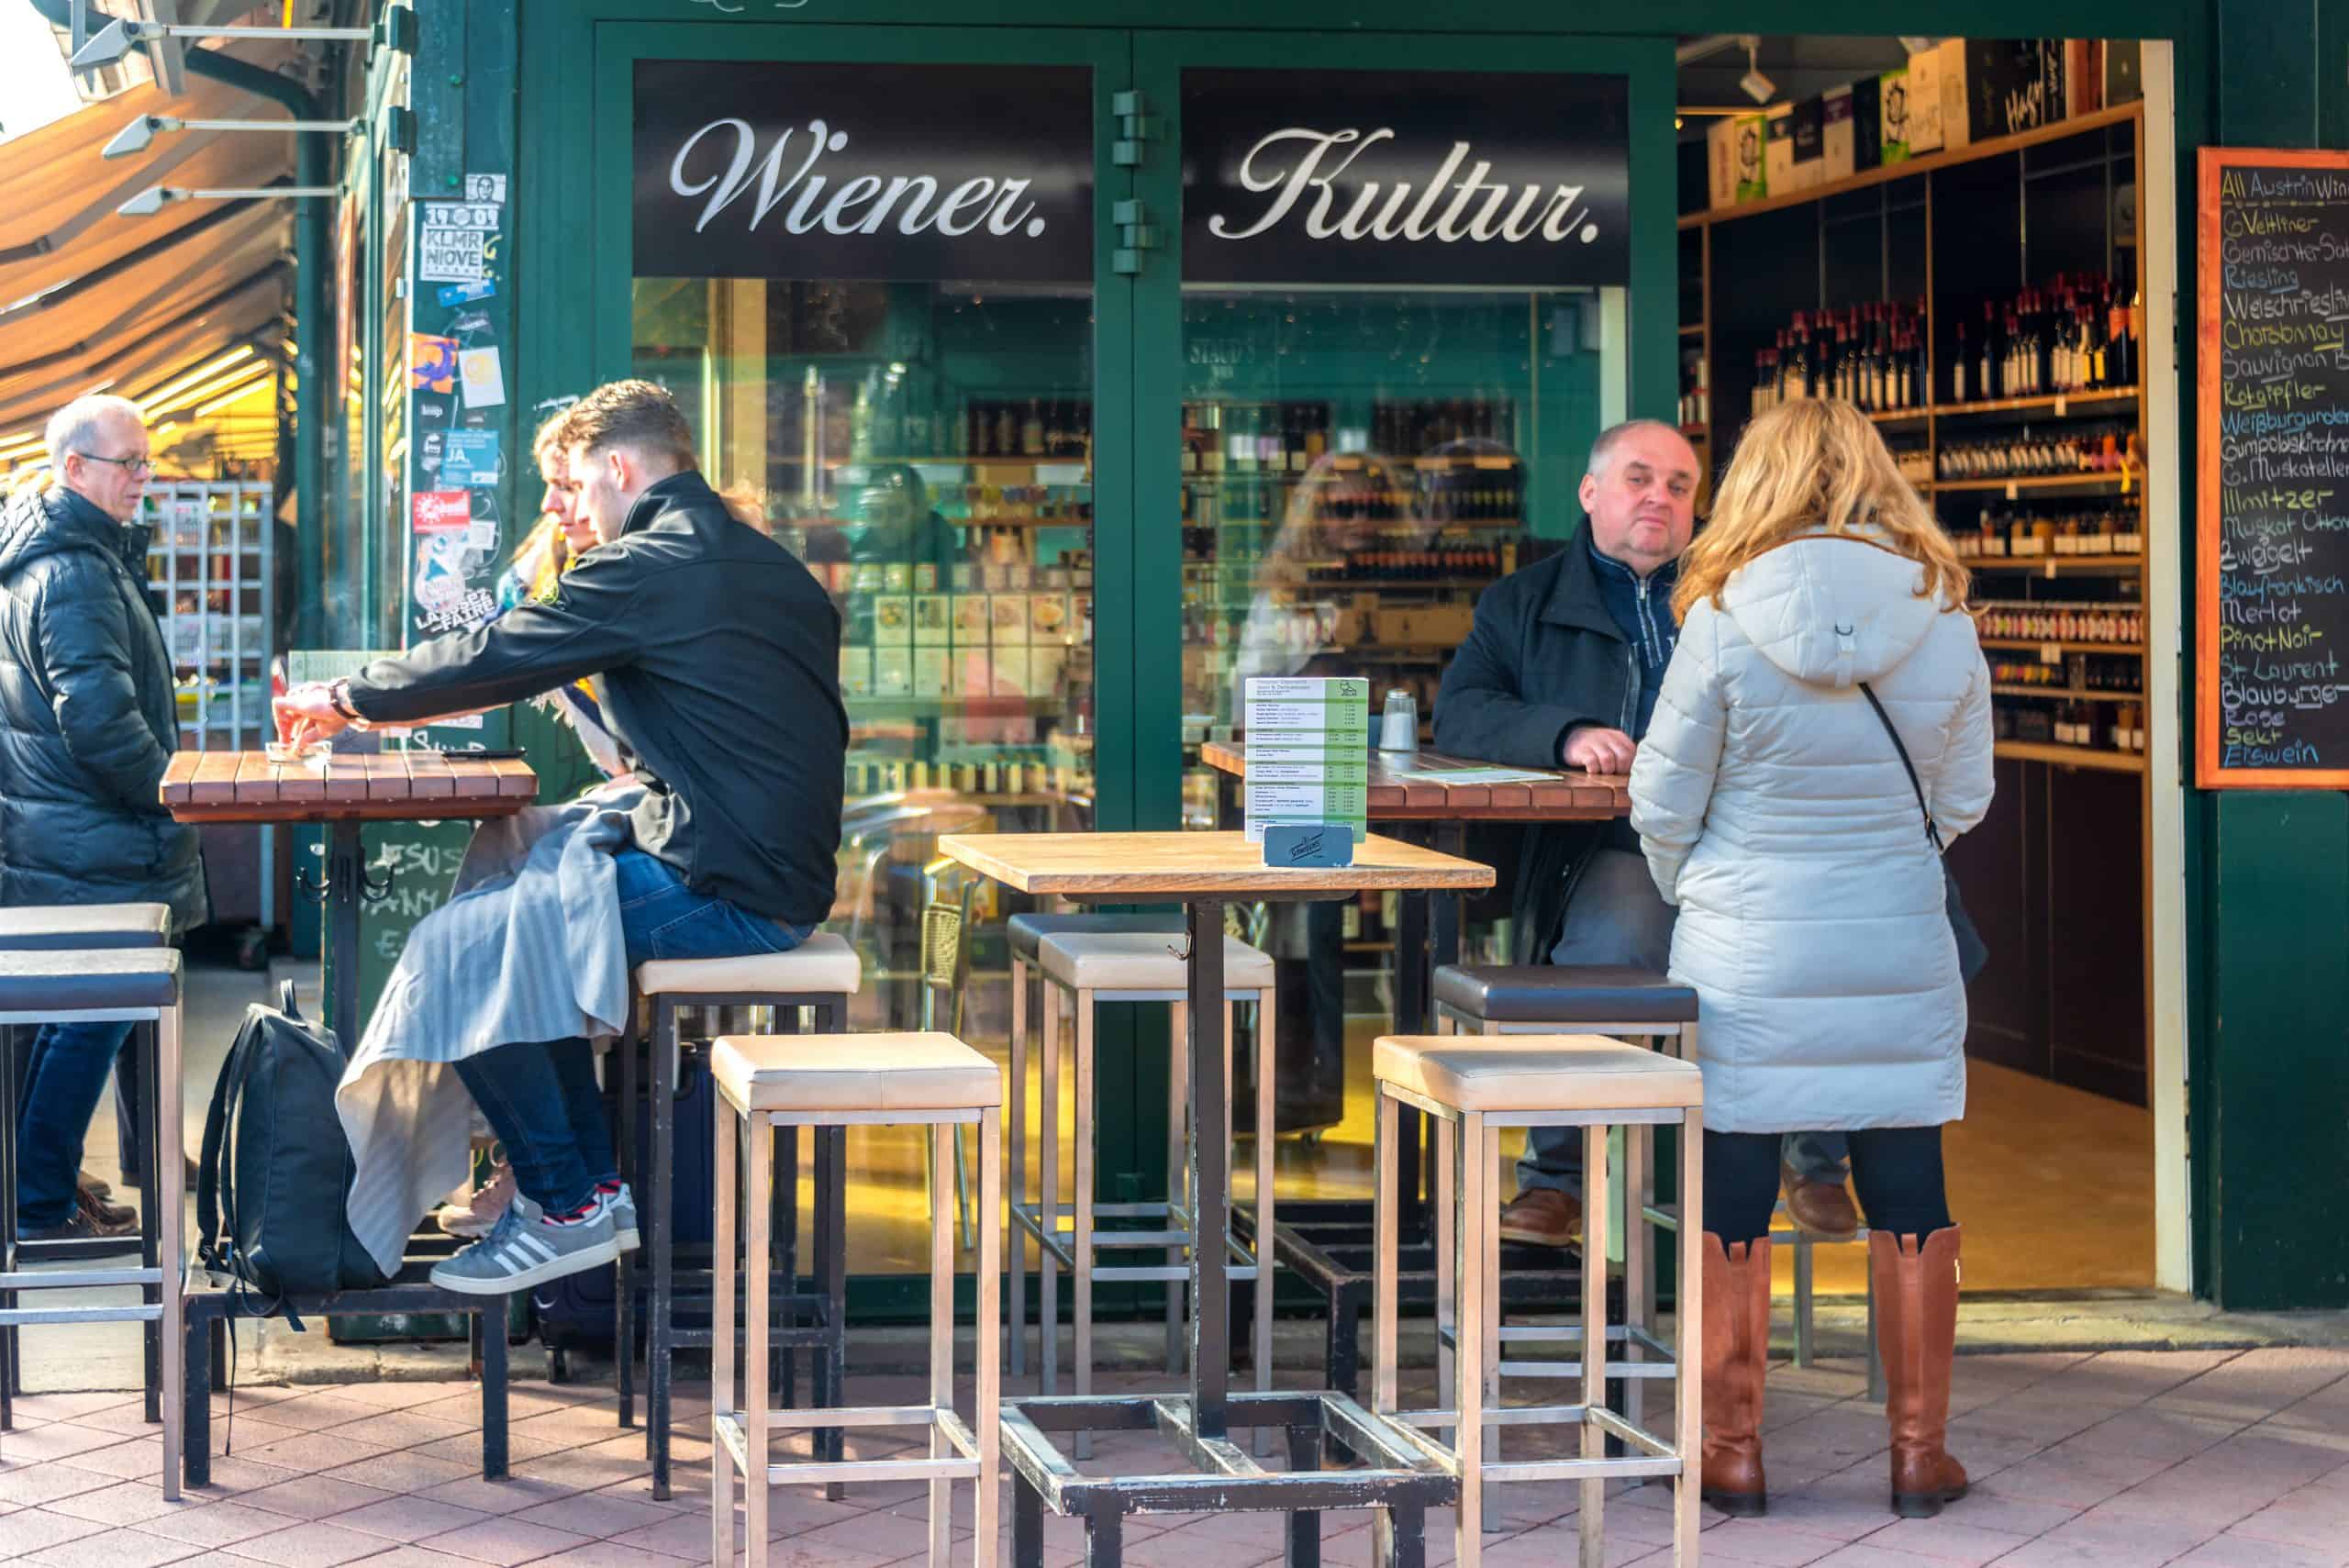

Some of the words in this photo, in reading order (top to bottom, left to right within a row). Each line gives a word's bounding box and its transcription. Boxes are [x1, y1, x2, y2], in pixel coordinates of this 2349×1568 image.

[669, 117, 1045, 237] Wiener.
[1208, 128, 1598, 242] Kultur.
[2221, 598, 2302, 624] Merlot
[2221, 624, 2277, 652] Pinot
[2278, 624, 2322, 652] Noir
[2254, 649, 2342, 681] Laurent
[2224, 737, 2319, 767] Eiswein
